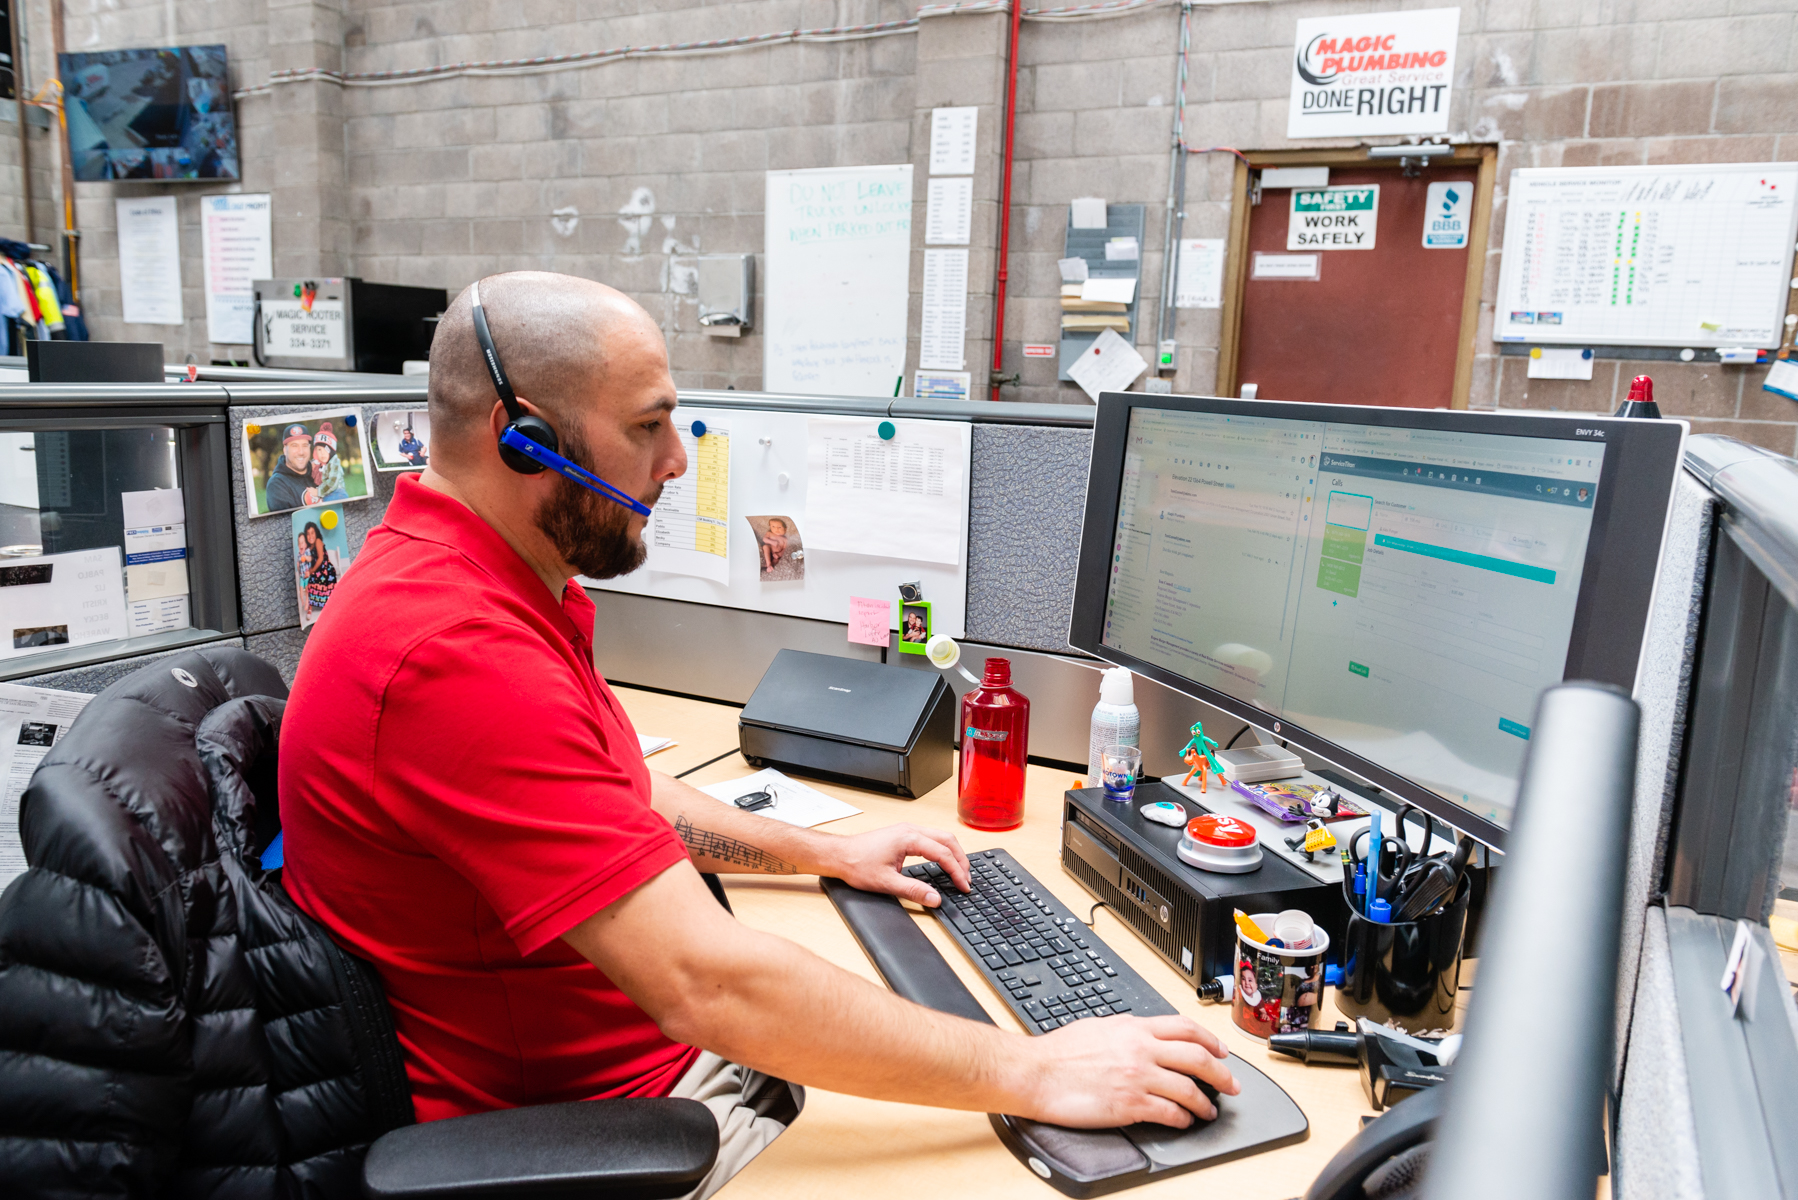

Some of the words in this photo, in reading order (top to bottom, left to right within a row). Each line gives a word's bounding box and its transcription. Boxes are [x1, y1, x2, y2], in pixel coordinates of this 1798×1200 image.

[1315, 34, 1396, 56] MAGIC
[1320, 50, 1447, 74] PLUMBING
[1342, 74, 1382, 86] Great
[1388, 71, 1444, 84] Service
[1303, 89, 1355, 109] DONE
[1357, 85, 1448, 116] RIGHT
[790, 182, 813, 204] DO
[822, 182, 846, 201] NOT
[858, 181, 906, 200] LEAVE
[1299, 190, 1370, 206] SAFETY
[1304, 214, 1360, 228] WORK
[1432, 220, 1462, 231] BBB
[1298, 232, 1365, 245] SAFELY
[276, 310, 302, 320] MAGIC
[291, 324, 326, 334] SERVICE
[290, 338, 331, 348] 334-3371
[486, 349, 504, 386] SENNHEISER
[1576, 428, 1593, 436] ENVY
[1330, 459, 1356, 468] ServiceTitan
[1172, 474, 1187, 482] Elevation
[1201, 478, 1213, 486] Powell
[1214, 480, 1224, 488] Street
[1256, 952, 1280, 965] Family
